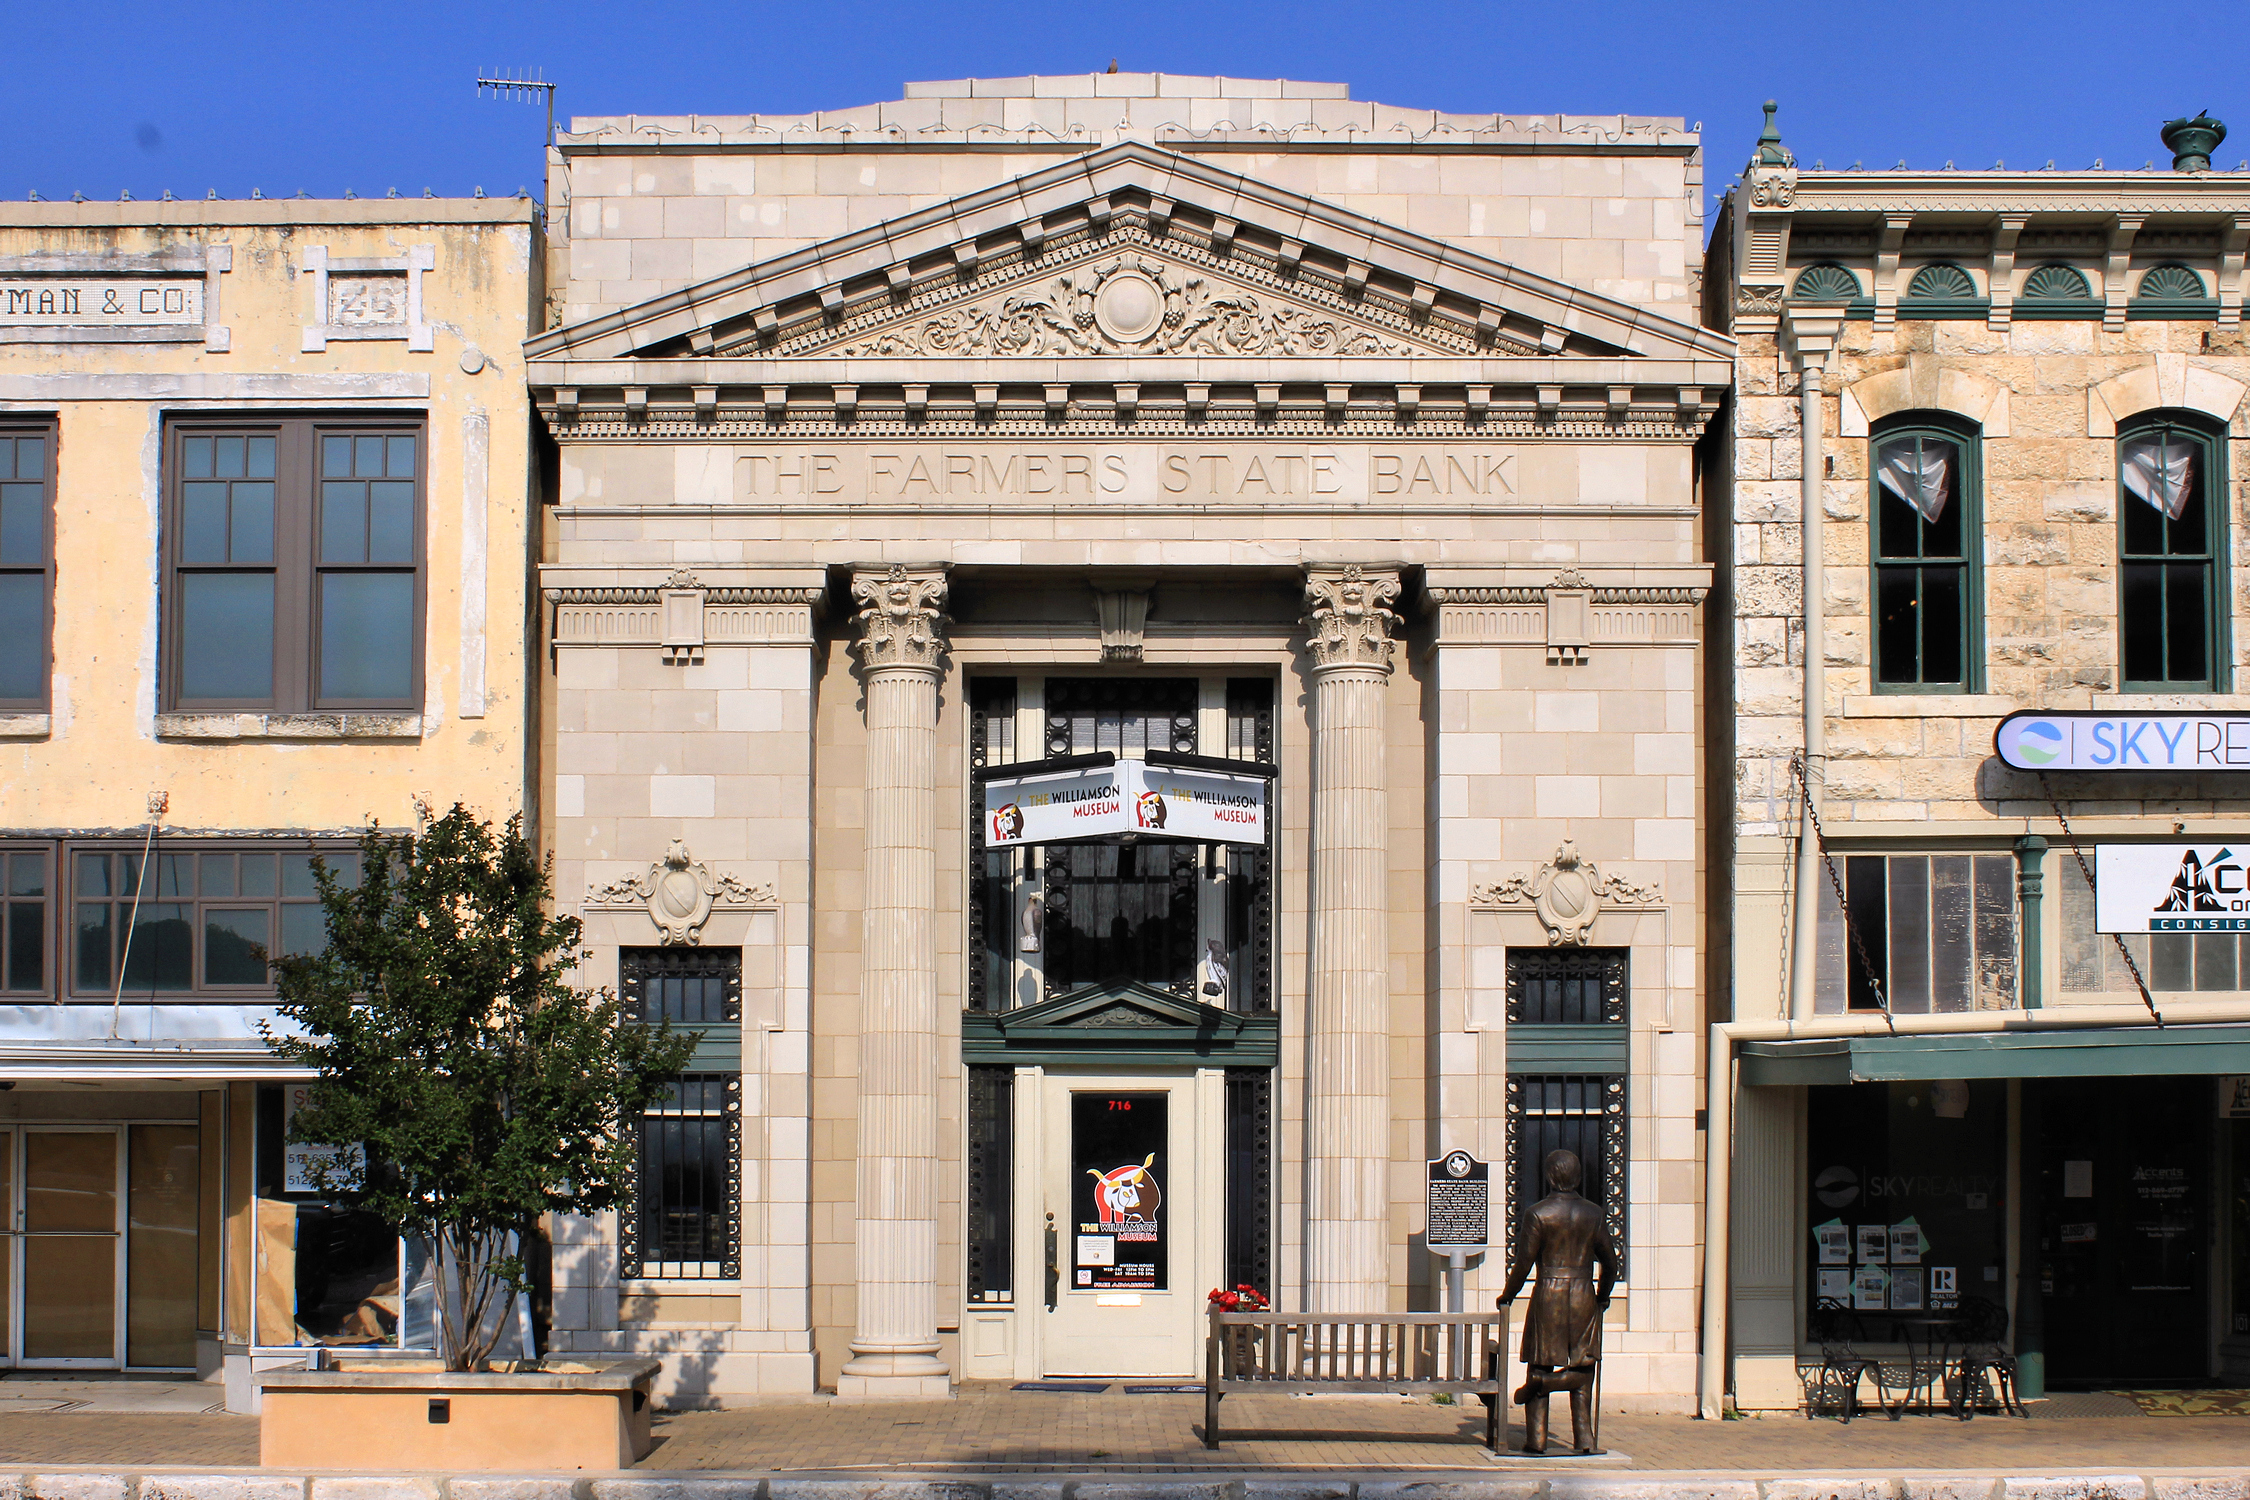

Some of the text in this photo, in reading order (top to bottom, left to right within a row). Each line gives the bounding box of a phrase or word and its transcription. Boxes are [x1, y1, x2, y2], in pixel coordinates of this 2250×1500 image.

[0, 288, 81, 314] MAN
[102, 288, 124, 314] &
[736, 453, 1517, 495] THE FARMERS STATE BANK
[1029, 785, 1120, 807] THE WILLIAMSON
[1172, 788, 1257, 809] THE WILLIAMSON
[1073, 801, 1120, 818] MUSEUM
[1214, 809, 1257, 825] MUSEUM
[1108, 1100, 1132, 1111] 716
[1080, 1222, 1158, 1233] THE WILLIAMSON
[2061, 1224, 2085, 1236] CLOSED
[1117, 1232, 1158, 1242] MUSEUM
[2234, 1316, 2249, 1331] 101
